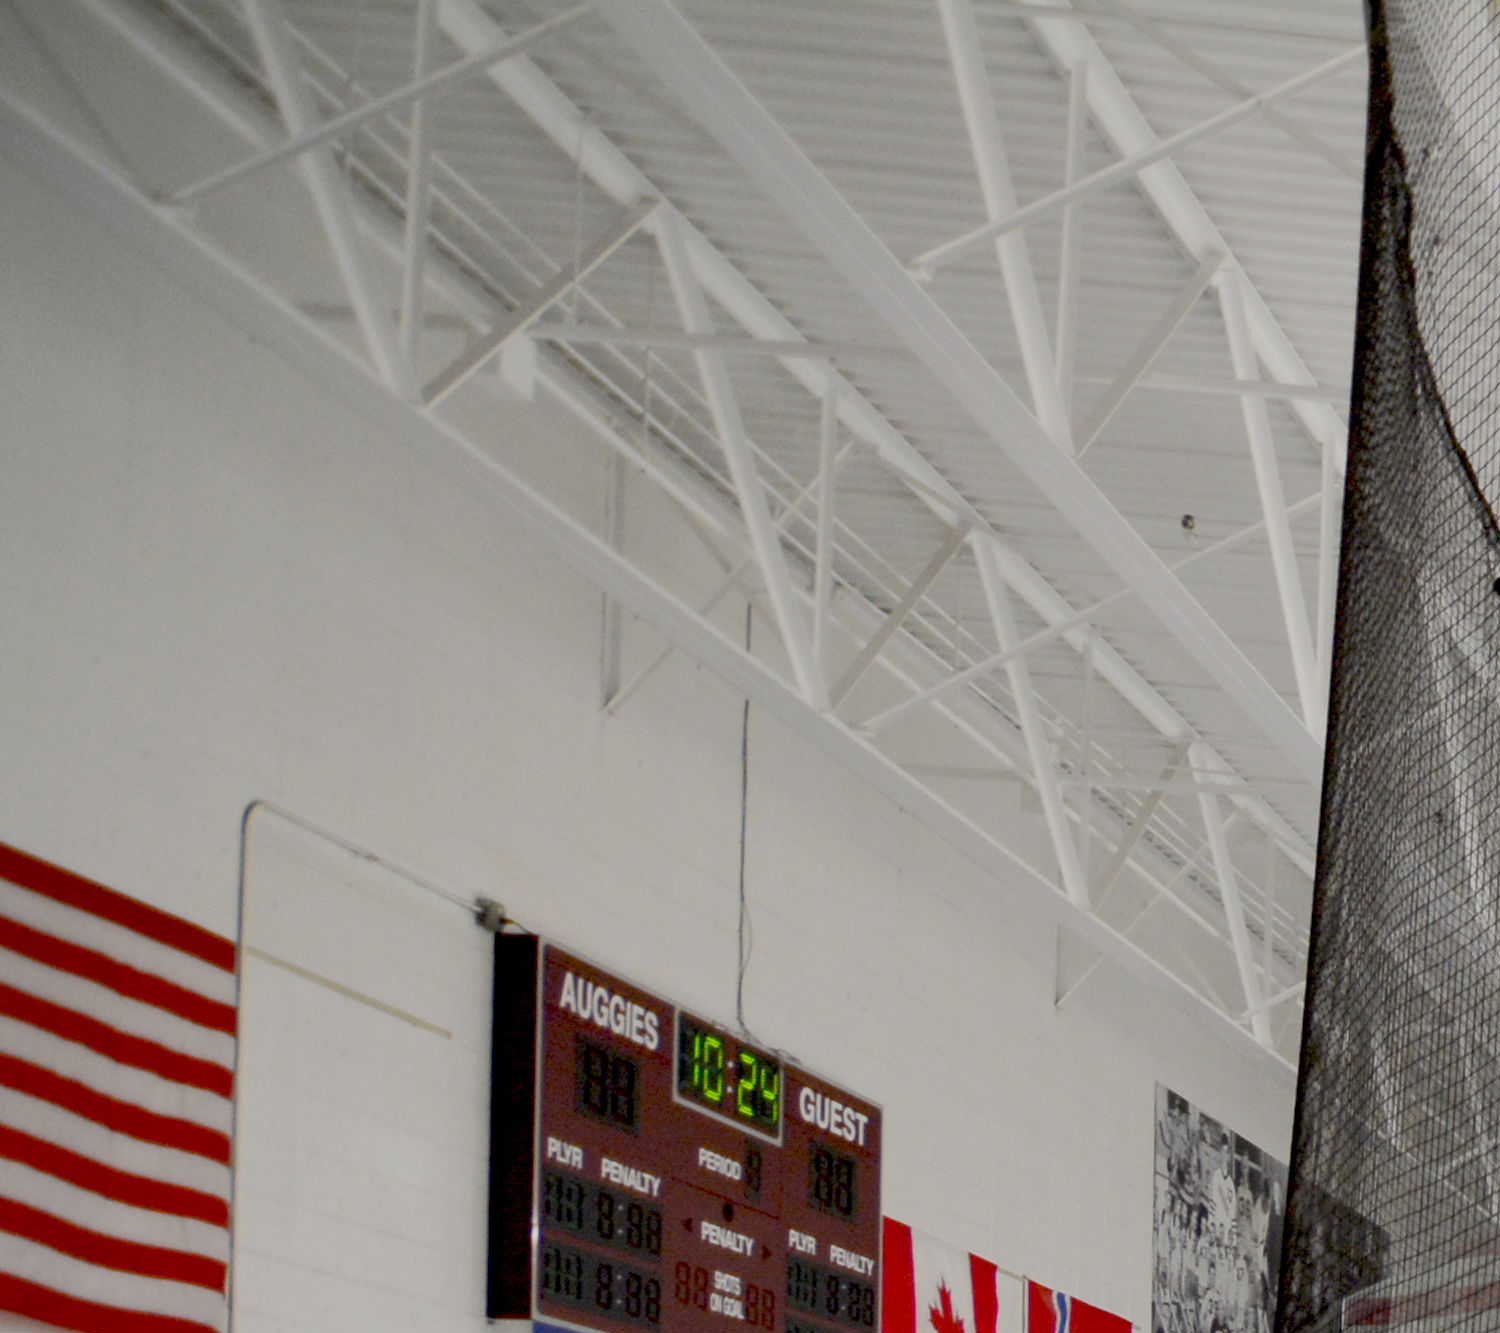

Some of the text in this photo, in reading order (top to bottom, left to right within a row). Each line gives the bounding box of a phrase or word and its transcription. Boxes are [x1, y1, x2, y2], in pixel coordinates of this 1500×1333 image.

[559, 971, 659, 1050] AUGGIES
[693, 1034, 779, 1125] 10:24
[799, 1086, 869, 1146] GUEST
[547, 1137, 661, 1197] PLYR PENALTY
[698, 1148, 742, 1180] PERIOD
[701, 1221, 754, 1256] PENALTY
[788, 1229, 874, 1276] PLYR PENALTY
[714, 1270, 741, 1296] SHOTS
